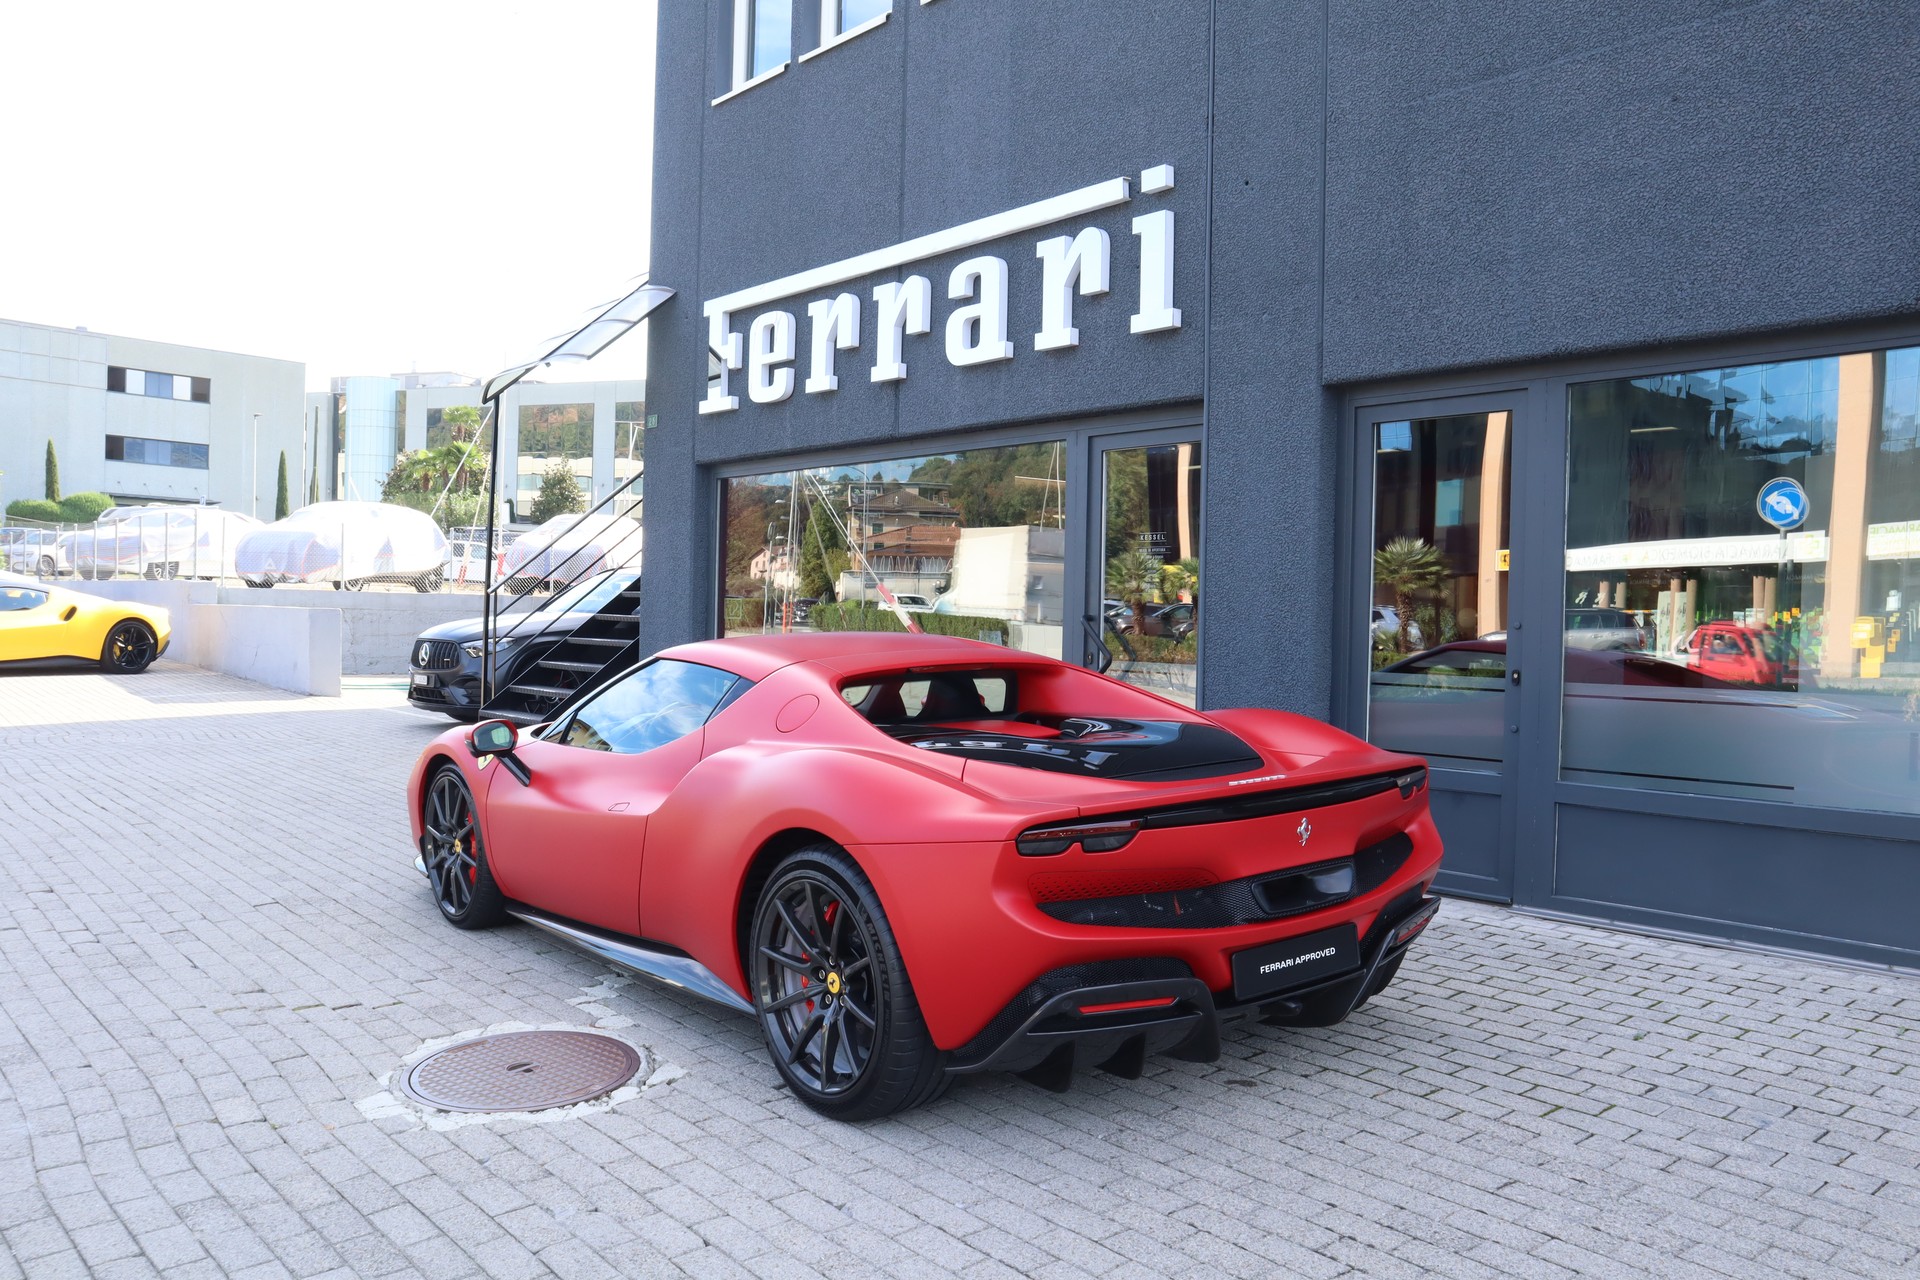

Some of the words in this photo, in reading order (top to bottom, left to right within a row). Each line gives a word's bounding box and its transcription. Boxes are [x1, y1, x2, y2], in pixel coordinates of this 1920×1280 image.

[699, 164, 1182, 415] Ferrari
[866, 921, 891, 1002] MICHELIN
[1260, 958, 1294, 975] FERRARI
[1295, 947, 1336, 965] APPROVED
